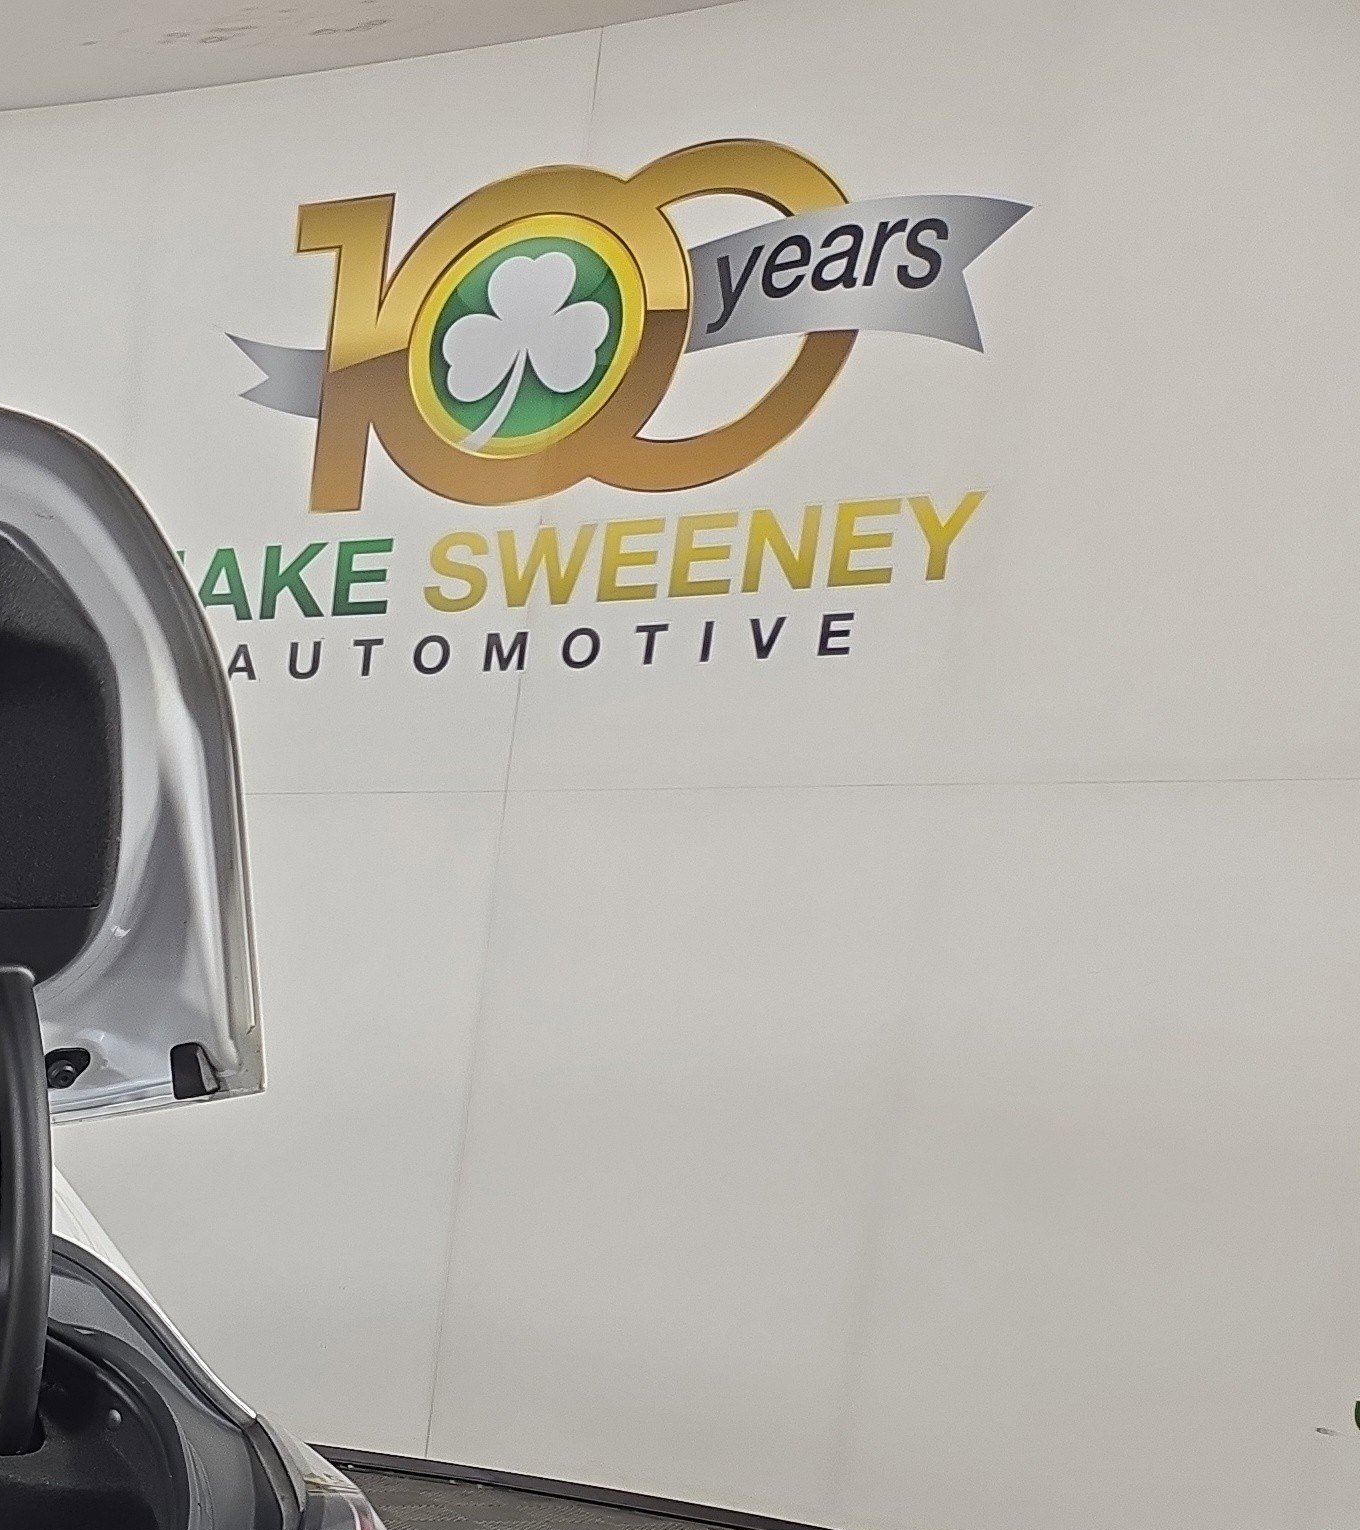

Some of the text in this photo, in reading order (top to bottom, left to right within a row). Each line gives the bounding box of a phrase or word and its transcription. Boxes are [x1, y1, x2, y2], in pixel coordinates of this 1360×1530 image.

[704, 212, 949, 335] years
[176, 490, 989, 622] AKE SWEENEY
[227, 612, 856, 681] AUTOMOTIVE
